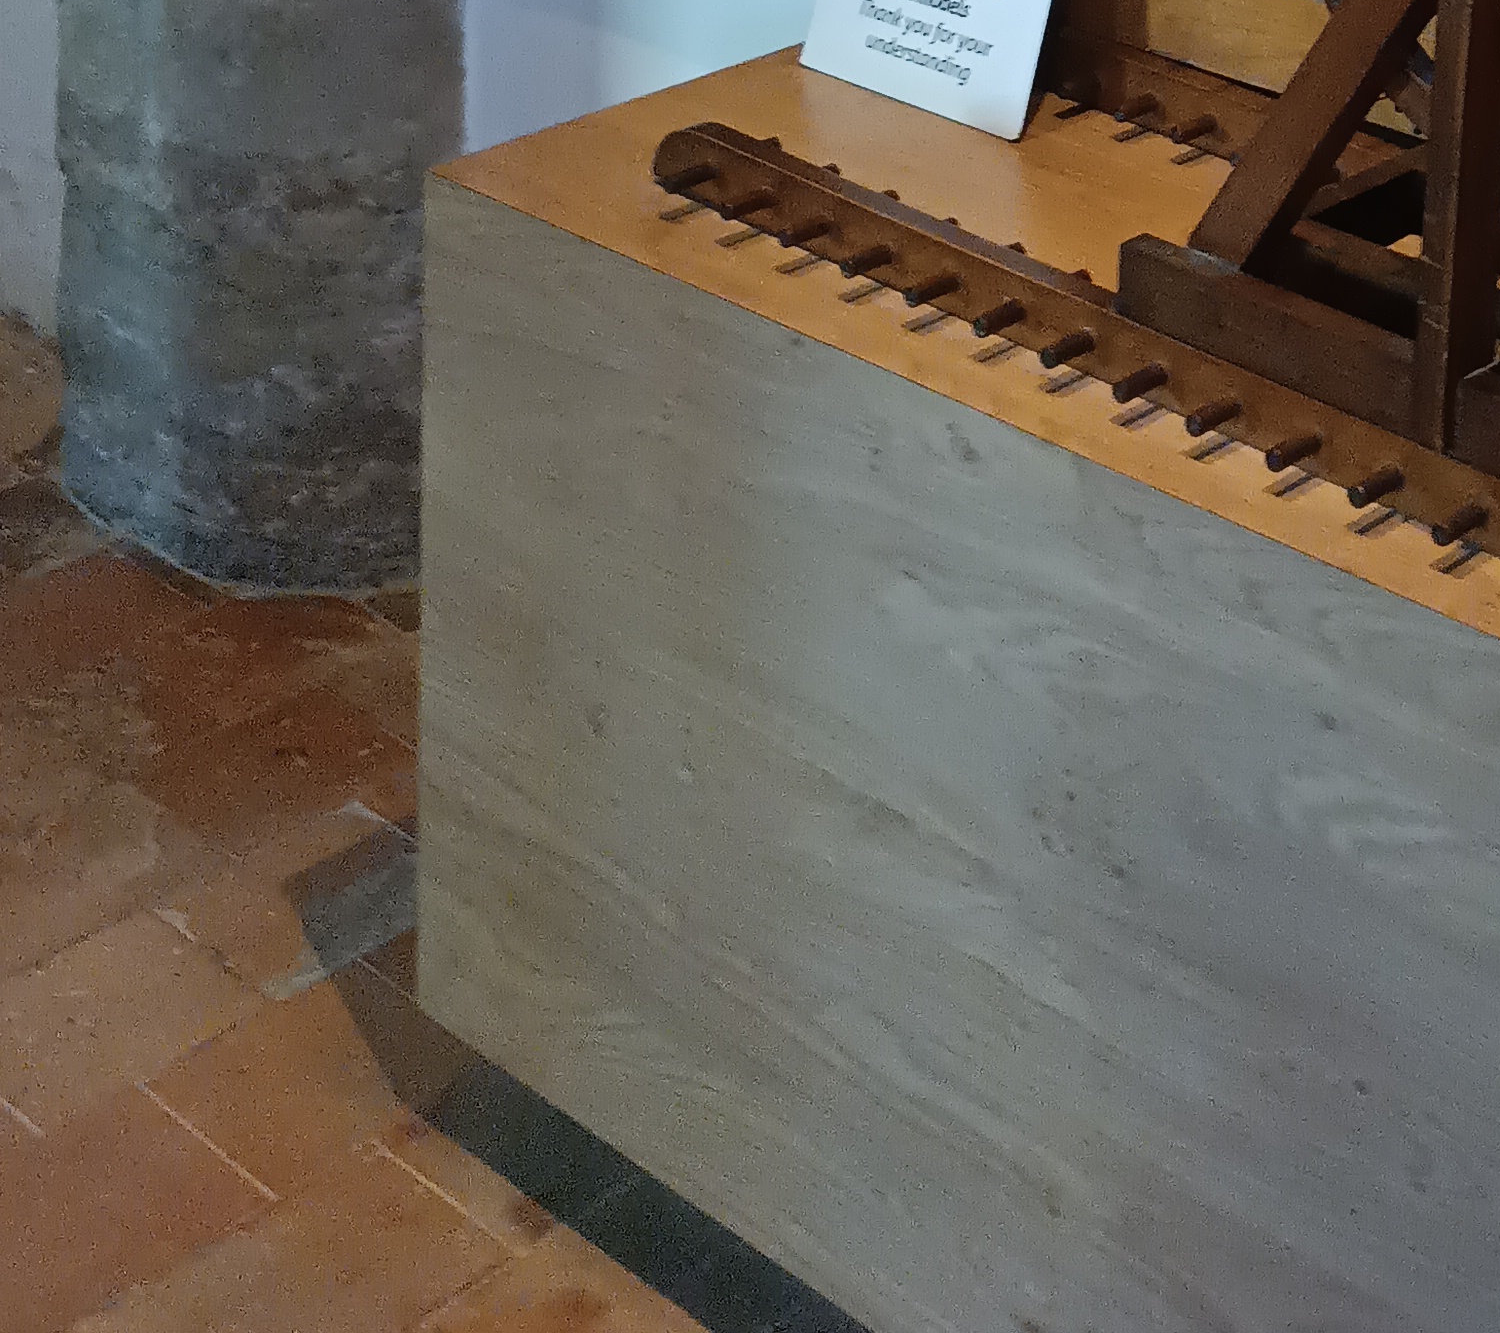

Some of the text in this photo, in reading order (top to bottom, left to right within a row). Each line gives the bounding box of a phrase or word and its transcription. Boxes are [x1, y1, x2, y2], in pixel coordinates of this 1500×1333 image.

[902, 16, 934, 37] you
[929, 22, 958, 45] for
[953, 34, 994, 57] your
[865, 34, 971, 86] understanding
